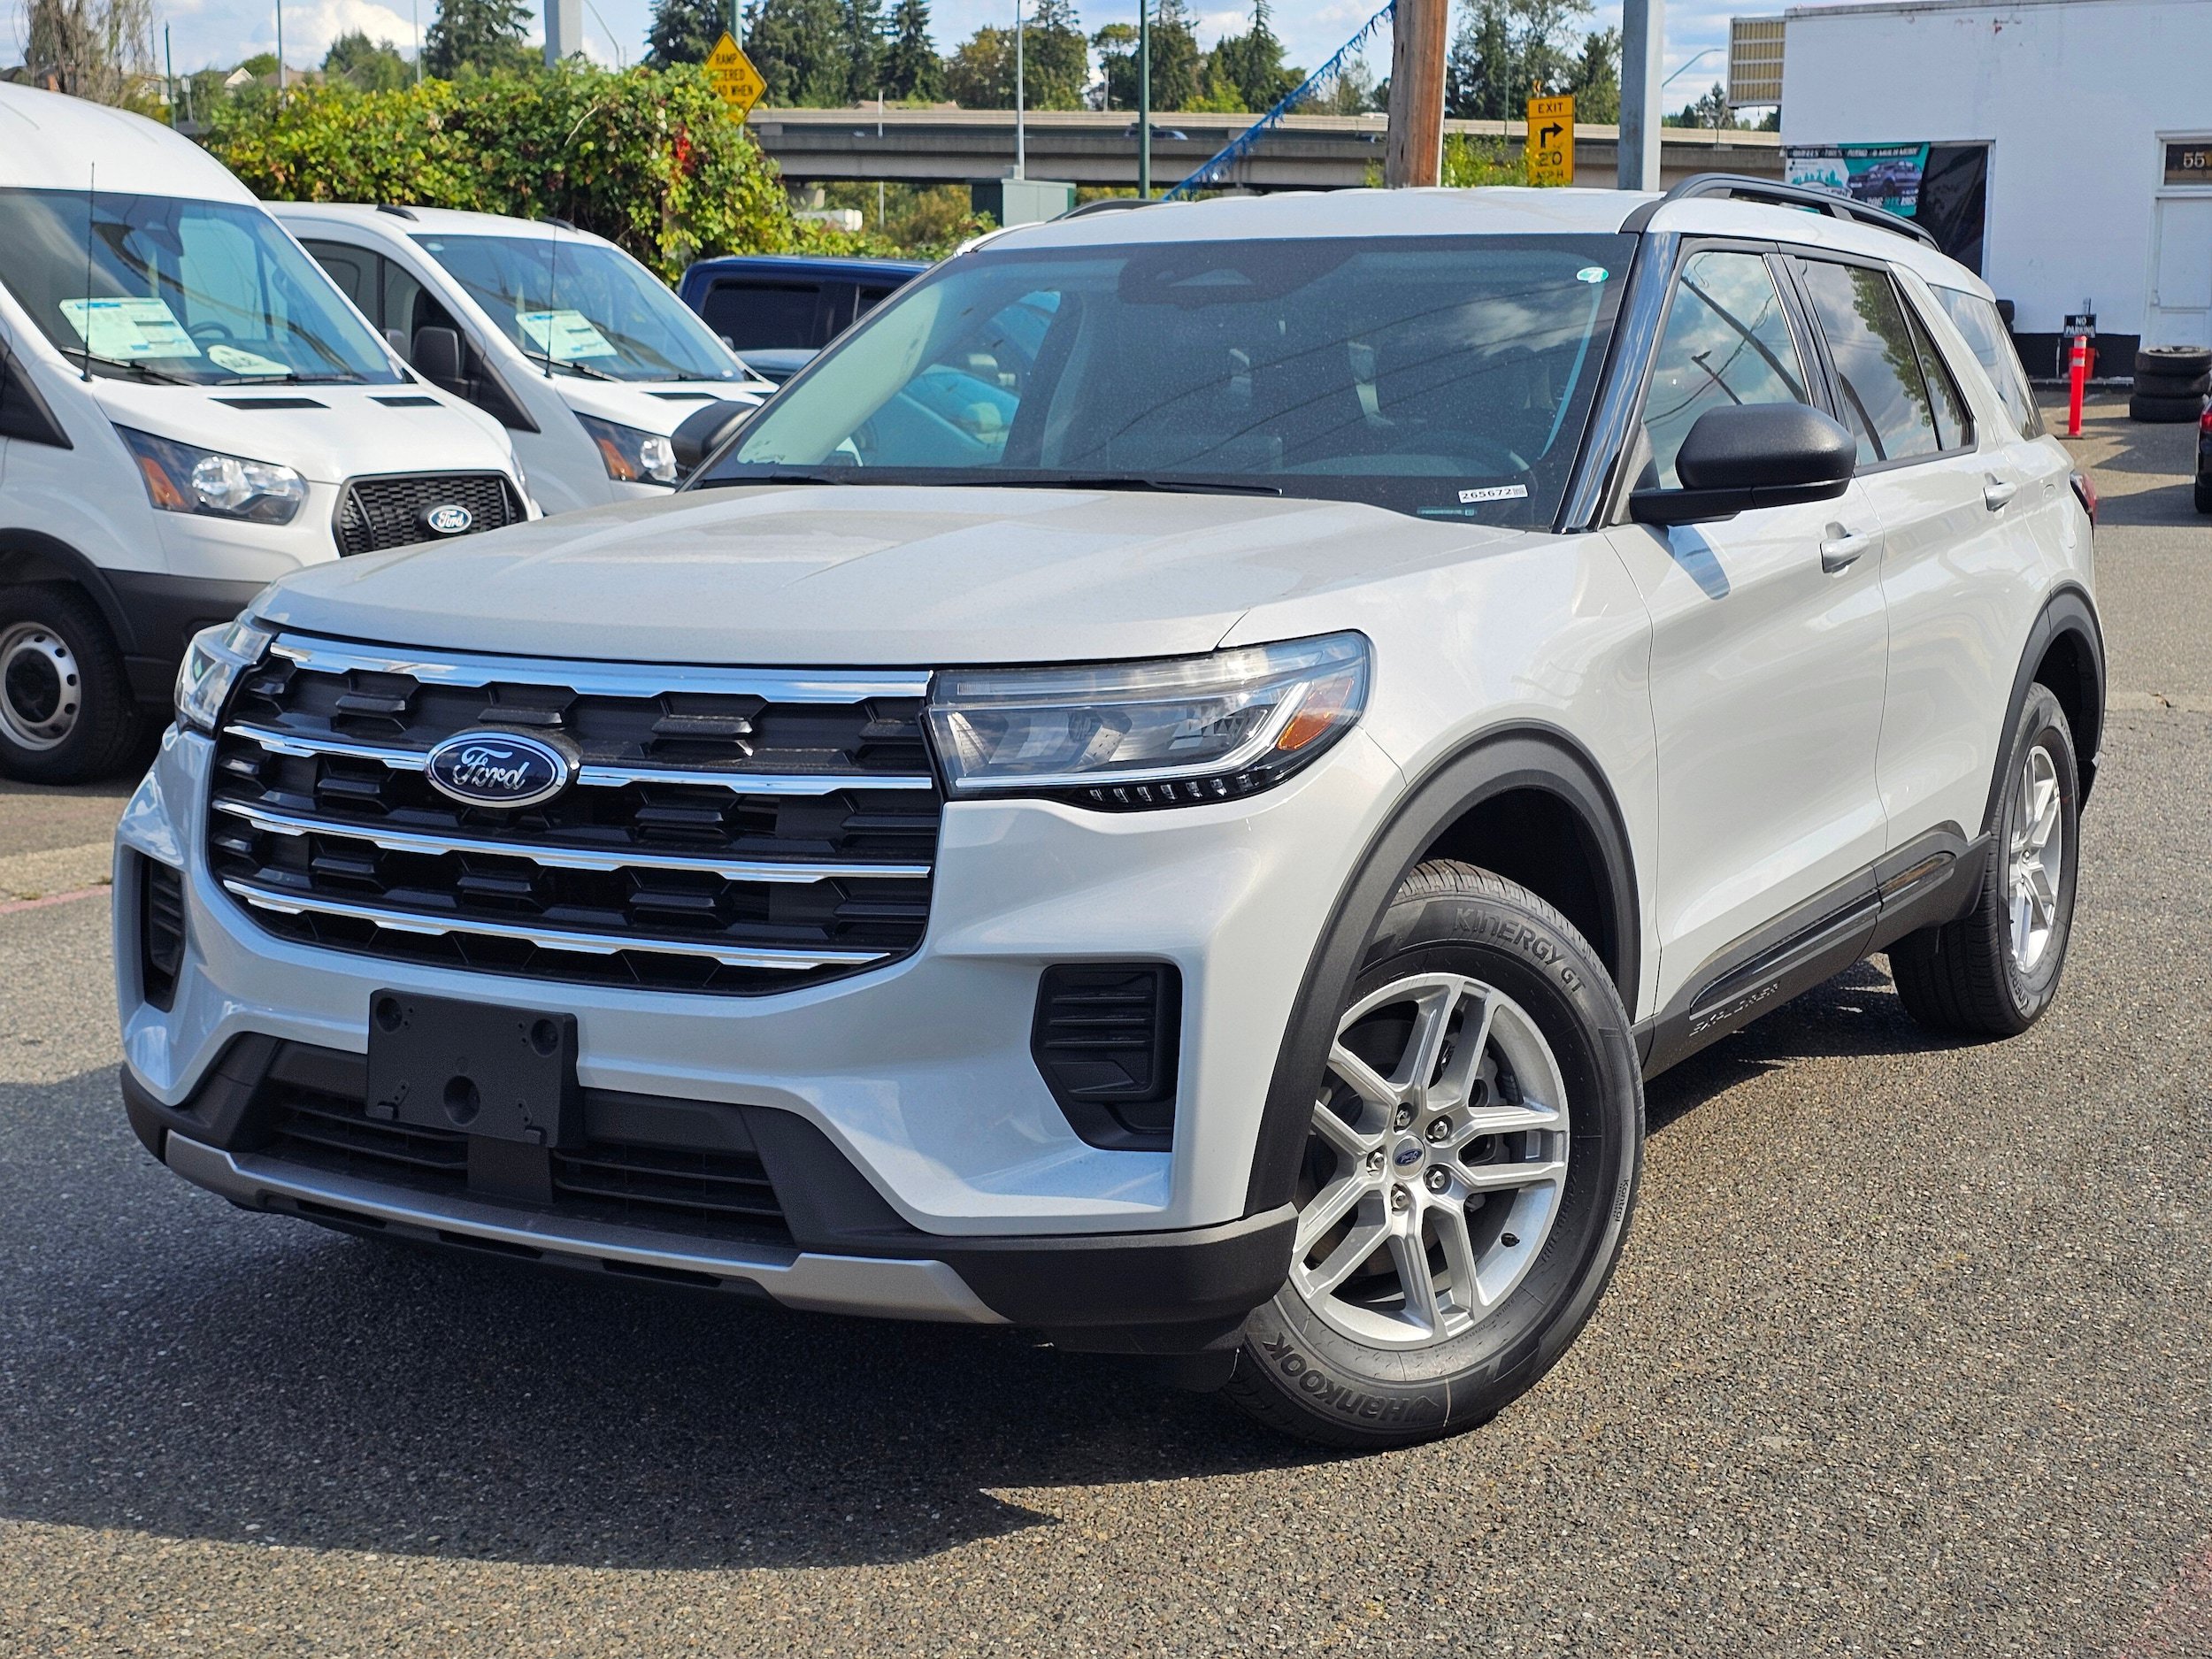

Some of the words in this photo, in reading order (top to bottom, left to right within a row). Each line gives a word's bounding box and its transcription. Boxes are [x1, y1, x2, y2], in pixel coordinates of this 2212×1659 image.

[715, 53, 738, 65] RAMP
[730, 84, 754, 97] WHEN
[1538, 102, 1563, 114] EXIT
[1538, 150, 1563, 167] 20
[2183, 151, 2205, 168] 55
[2075, 316, 2087, 326] NO
[2065, 326, 2096, 339] PARKING
[1462, 488, 1512, 501] 265672
[437, 510, 465, 528] Ford
[453, 746, 530, 791] Ford
[1561, 966, 1586, 993] GT
[1615, 1179, 1630, 1222] Kontrol
